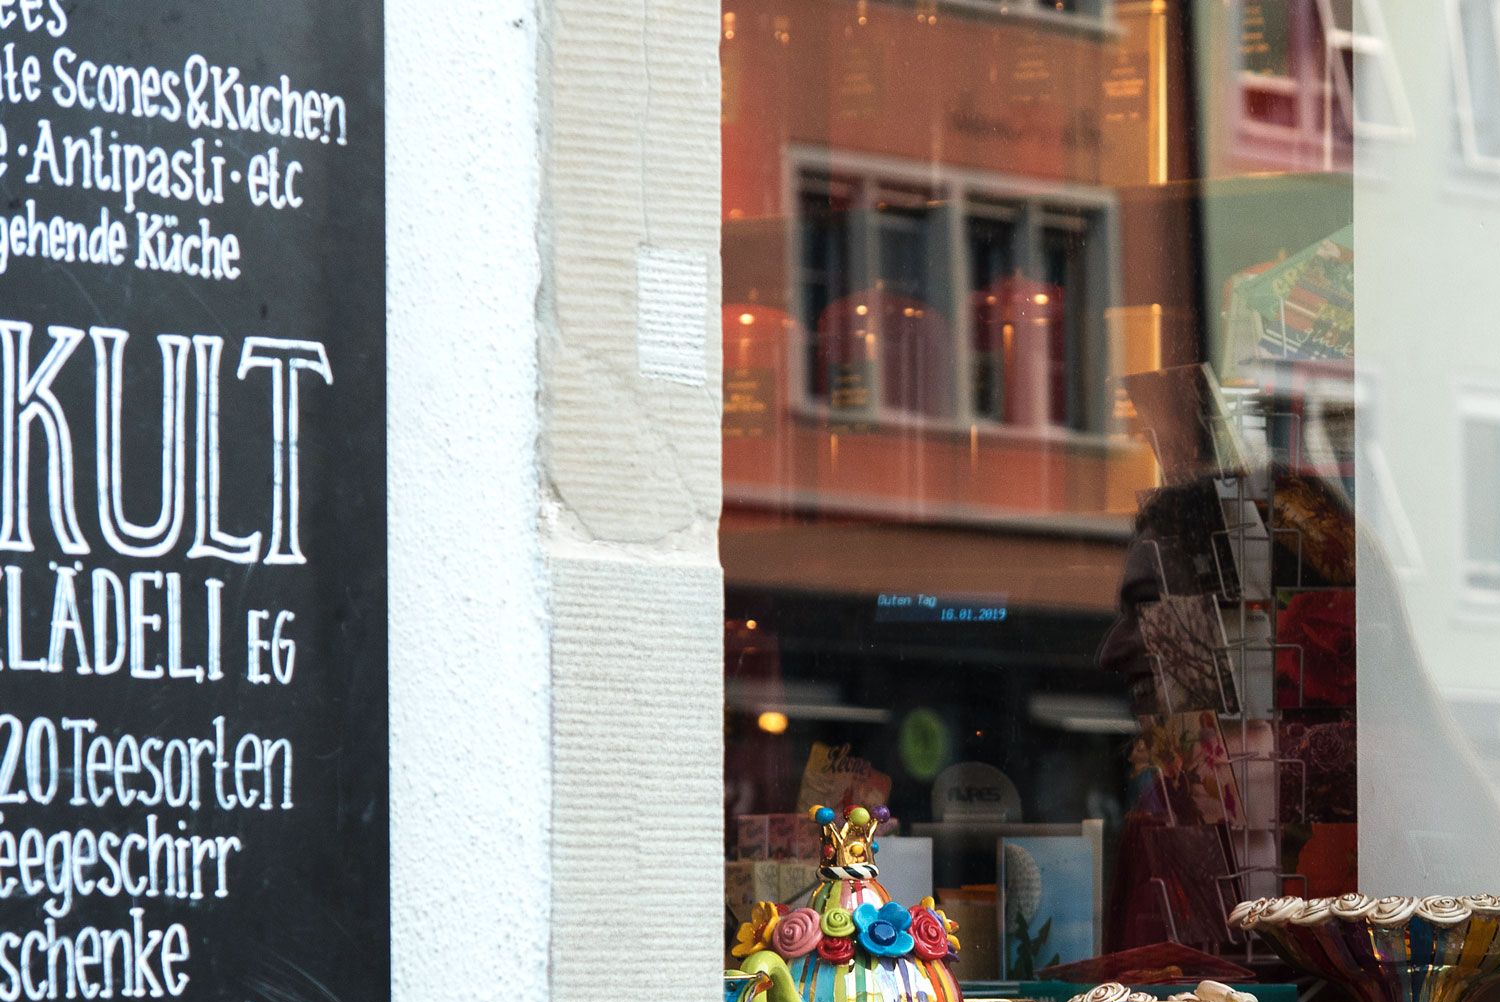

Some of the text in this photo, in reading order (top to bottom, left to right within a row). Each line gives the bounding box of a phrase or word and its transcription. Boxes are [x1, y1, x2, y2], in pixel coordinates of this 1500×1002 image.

[0, 43, 41, 104] te
[134, 211, 241, 280] Küche
[0, 319, 334, 565] KULT
[0, 560, 297, 684] LÄDELI EG
[61, 715, 294, 811] Teesorten
[0, 813, 242, 918] eegeschirr
[0, 906, 190, 1002] schenke
